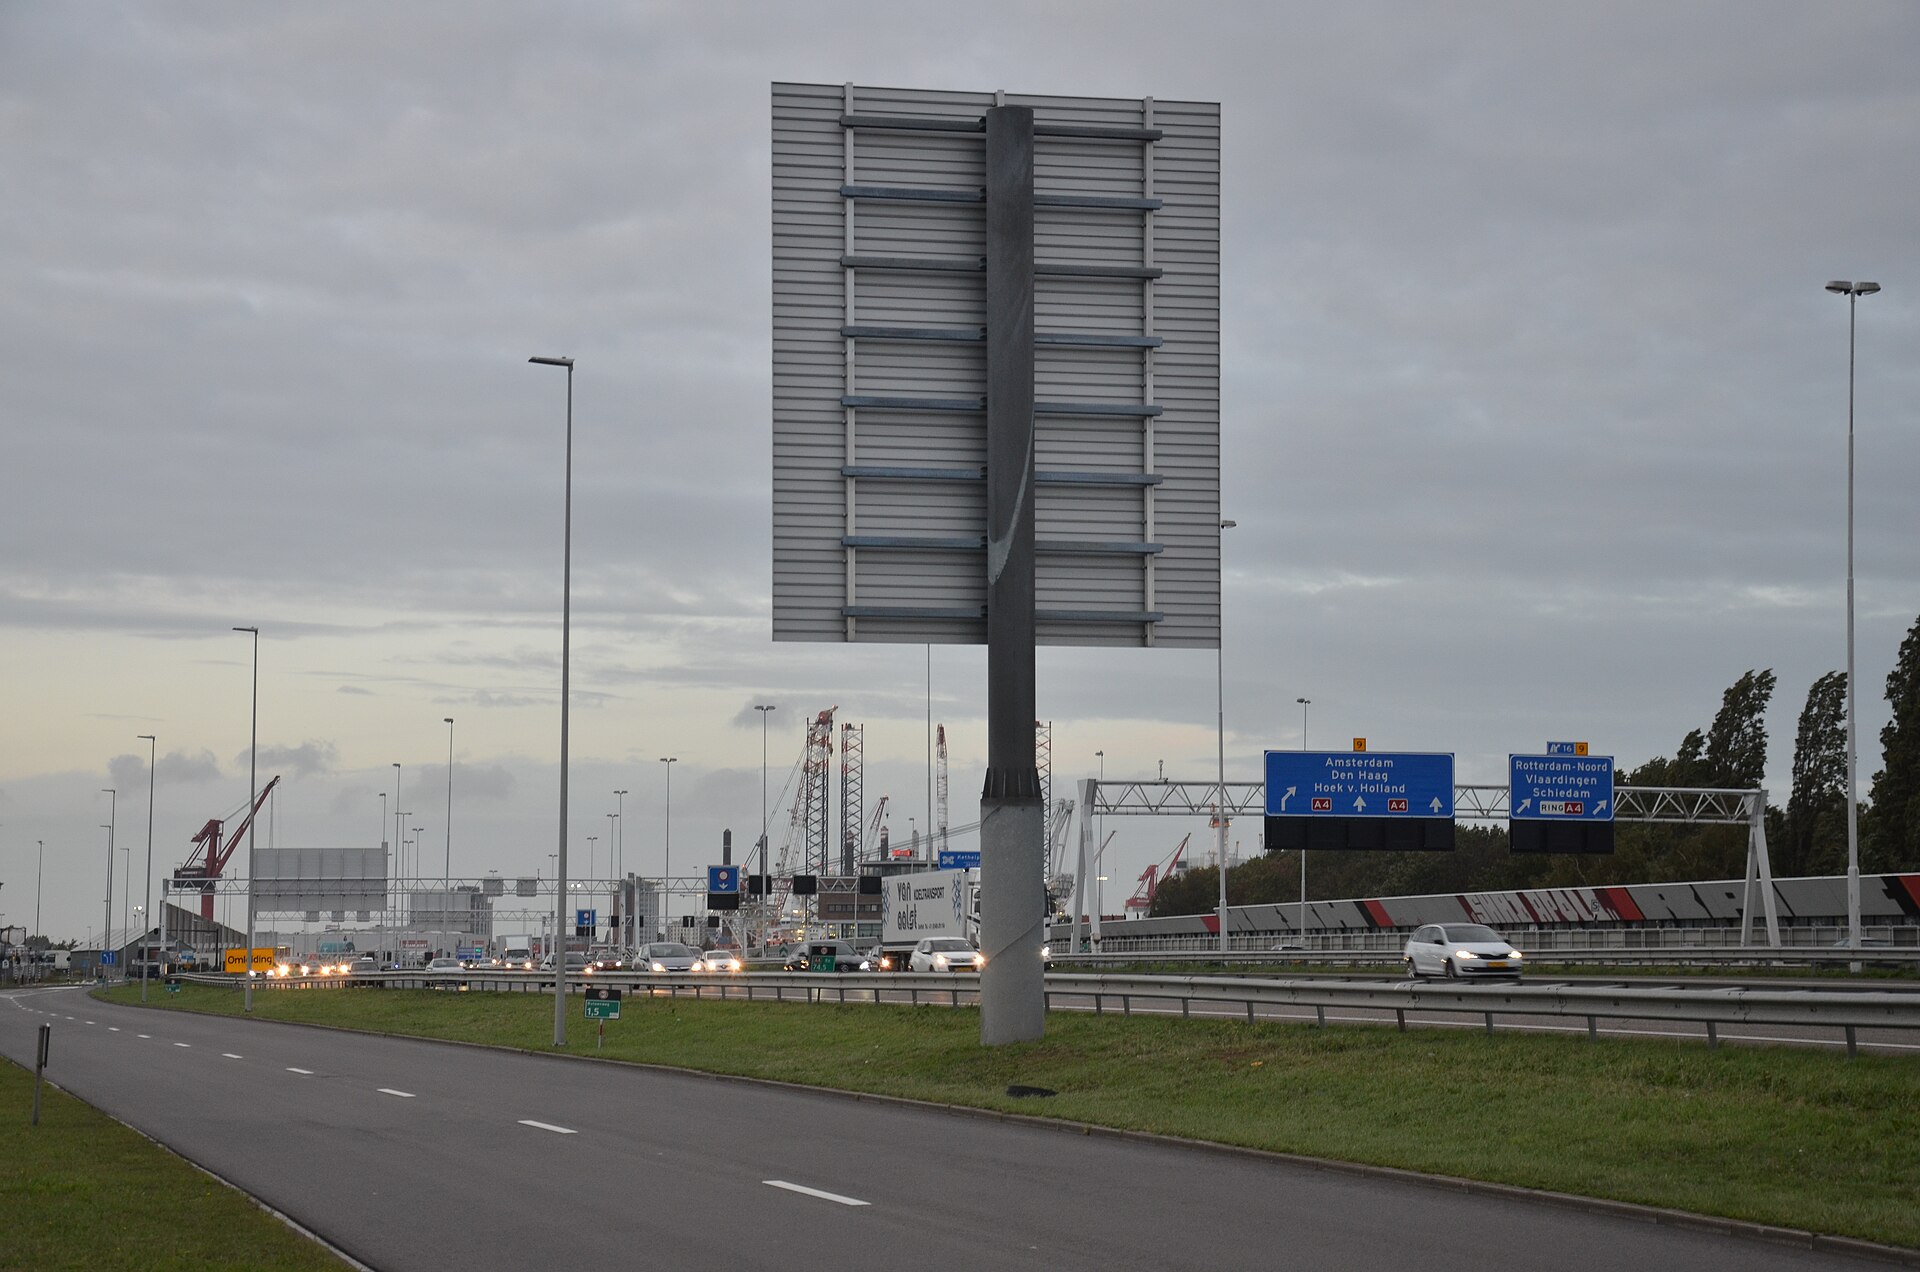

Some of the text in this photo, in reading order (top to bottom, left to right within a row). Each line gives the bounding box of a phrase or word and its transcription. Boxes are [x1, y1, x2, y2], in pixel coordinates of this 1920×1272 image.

[1356, 741, 1362, 749] 9
[1563, 744, 1584, 753] 16 9
[1325, 757, 1394, 768] Amsterdam
[1515, 761, 1608, 772] Rotterdam-Noord
[1331, 770, 1388, 782] Den Haag
[1525, 774, 1597, 787] Vlaardingen
[1314, 783, 1343, 793] Hoek
[1360, 783, 1406, 794] Holland
[1533, 787, 1590, 798] Schiedam
[1314, 800, 1330, 809] A4
[1390, 801, 1406, 810] A4
[1541, 804, 1581, 812] RING A4
[227, 955, 272, 965] Omliding
[587, 1007, 600, 1017] 1,5
